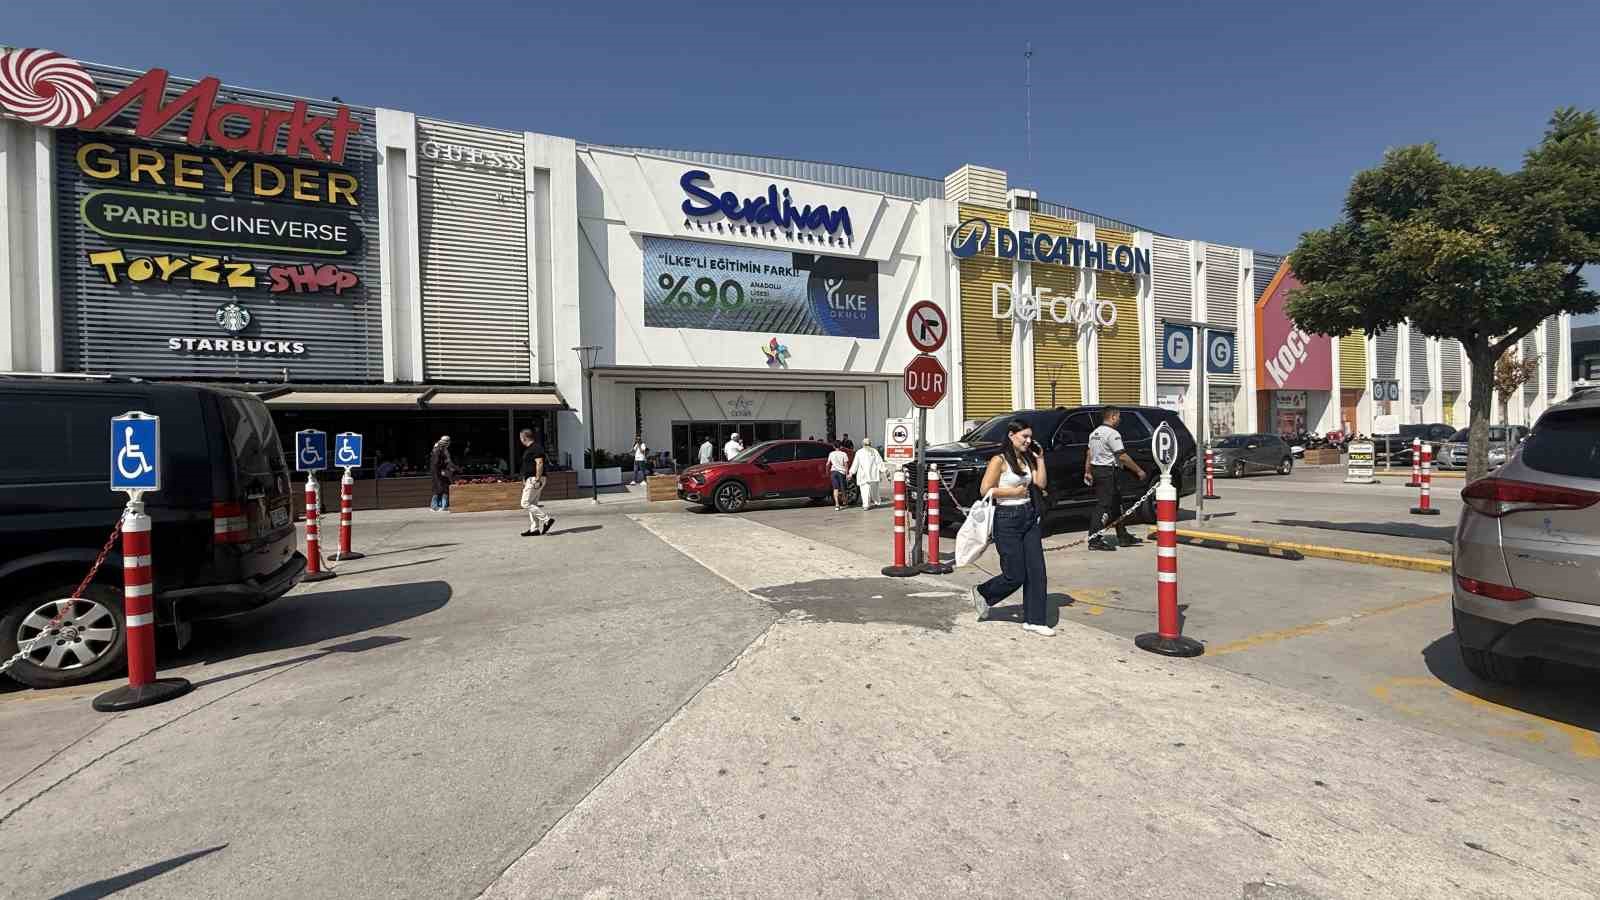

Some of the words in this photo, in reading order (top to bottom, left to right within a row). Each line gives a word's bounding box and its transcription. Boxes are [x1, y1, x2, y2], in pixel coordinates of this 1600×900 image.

[77, 68, 361, 164] Markt
[421, 140, 525, 170] GUESS
[76, 143, 359, 206] GREYDER
[680, 170, 854, 237] Serdivan
[211, 214, 348, 242] CINEVERSE
[996, 226, 1151, 274] DECATHLON
[268, 264, 359, 296] SHOP
[658, 272, 744, 313] %90
[992, 282, 1117, 326] DeFacto
[168, 337, 305, 354] STARBUCKS
[1172, 337, 1184, 357] F
[1214, 342, 1227, 362] G
[907, 371, 944, 392] DUR
[1159, 432, 1171, 461] P
